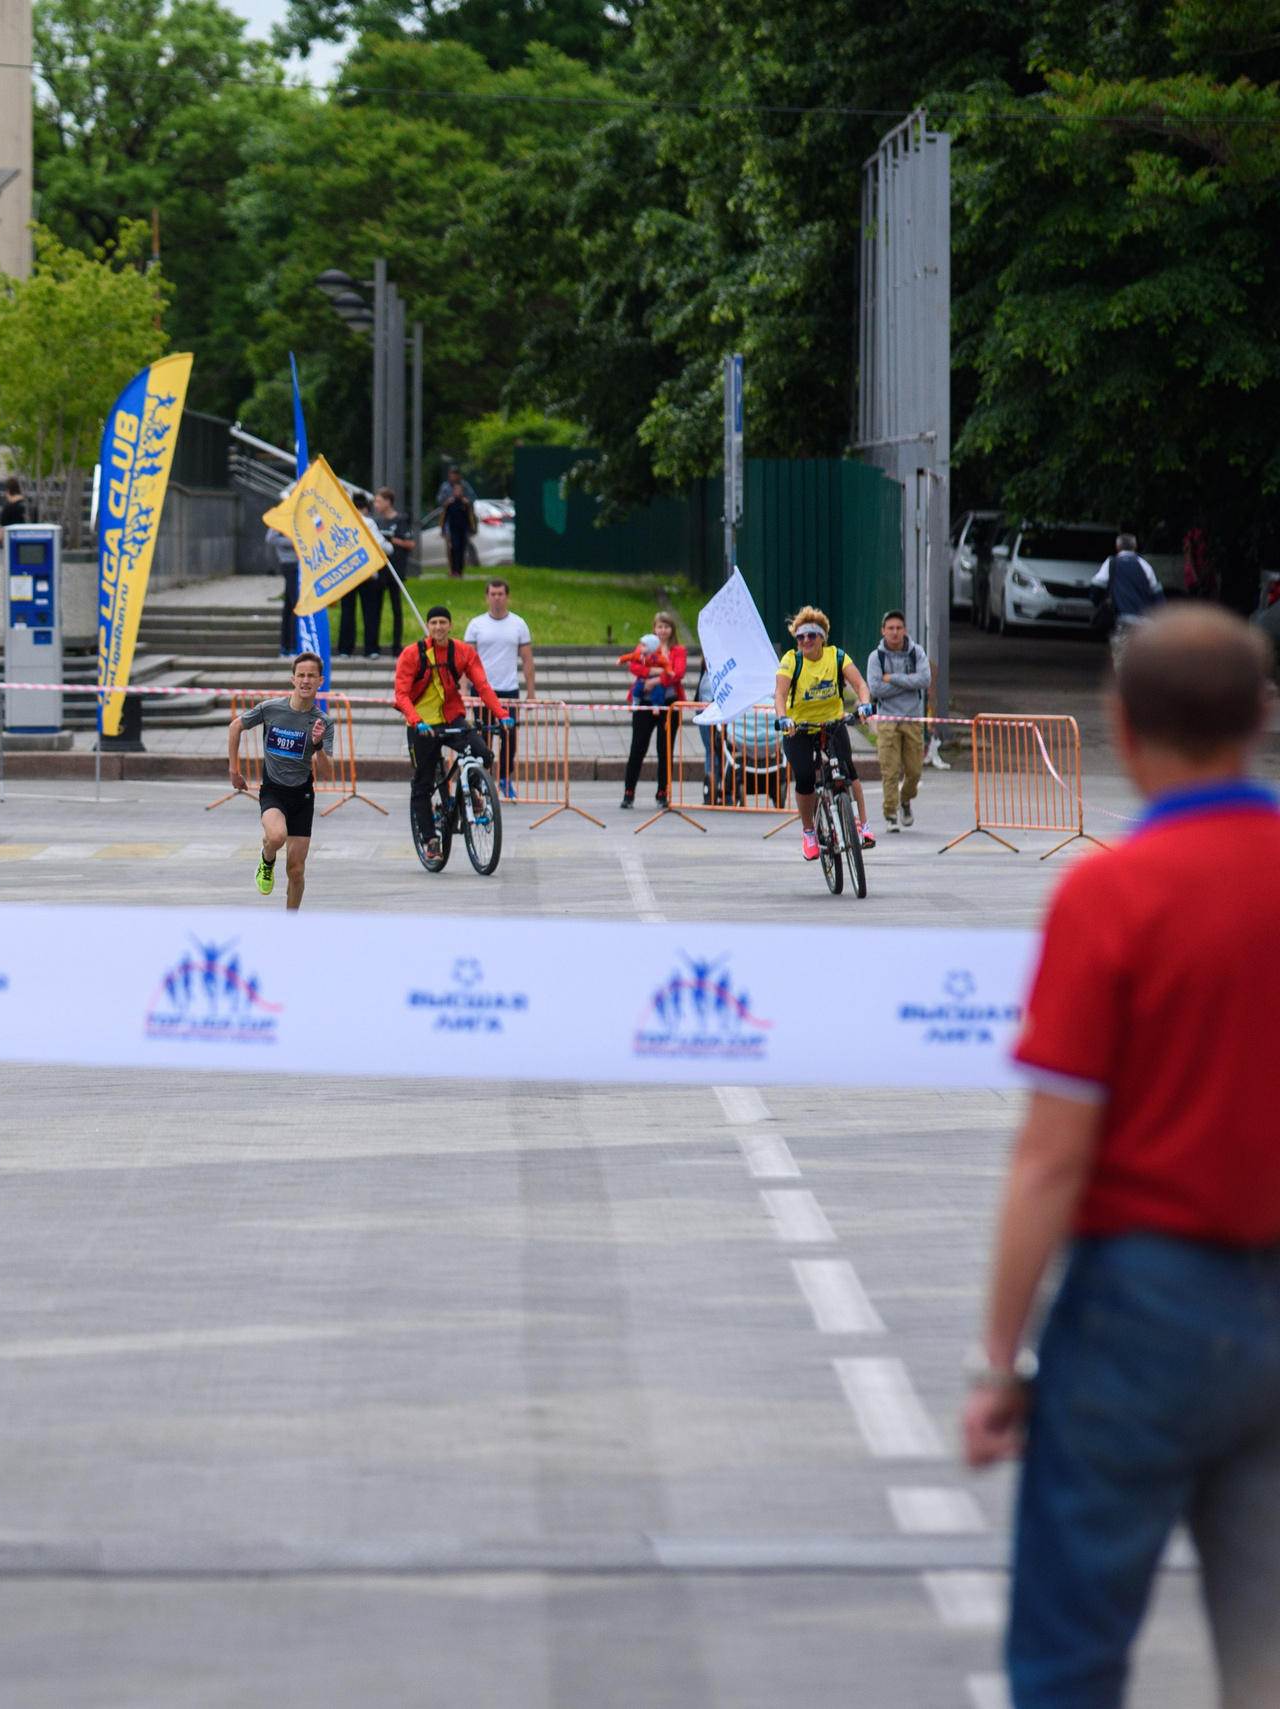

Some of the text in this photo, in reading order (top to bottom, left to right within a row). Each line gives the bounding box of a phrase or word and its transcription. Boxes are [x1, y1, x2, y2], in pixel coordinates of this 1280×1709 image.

[108, 409, 139, 519] CLUB
[100, 527, 123, 621] LIGA
[277, 737, 295, 749] 9019
